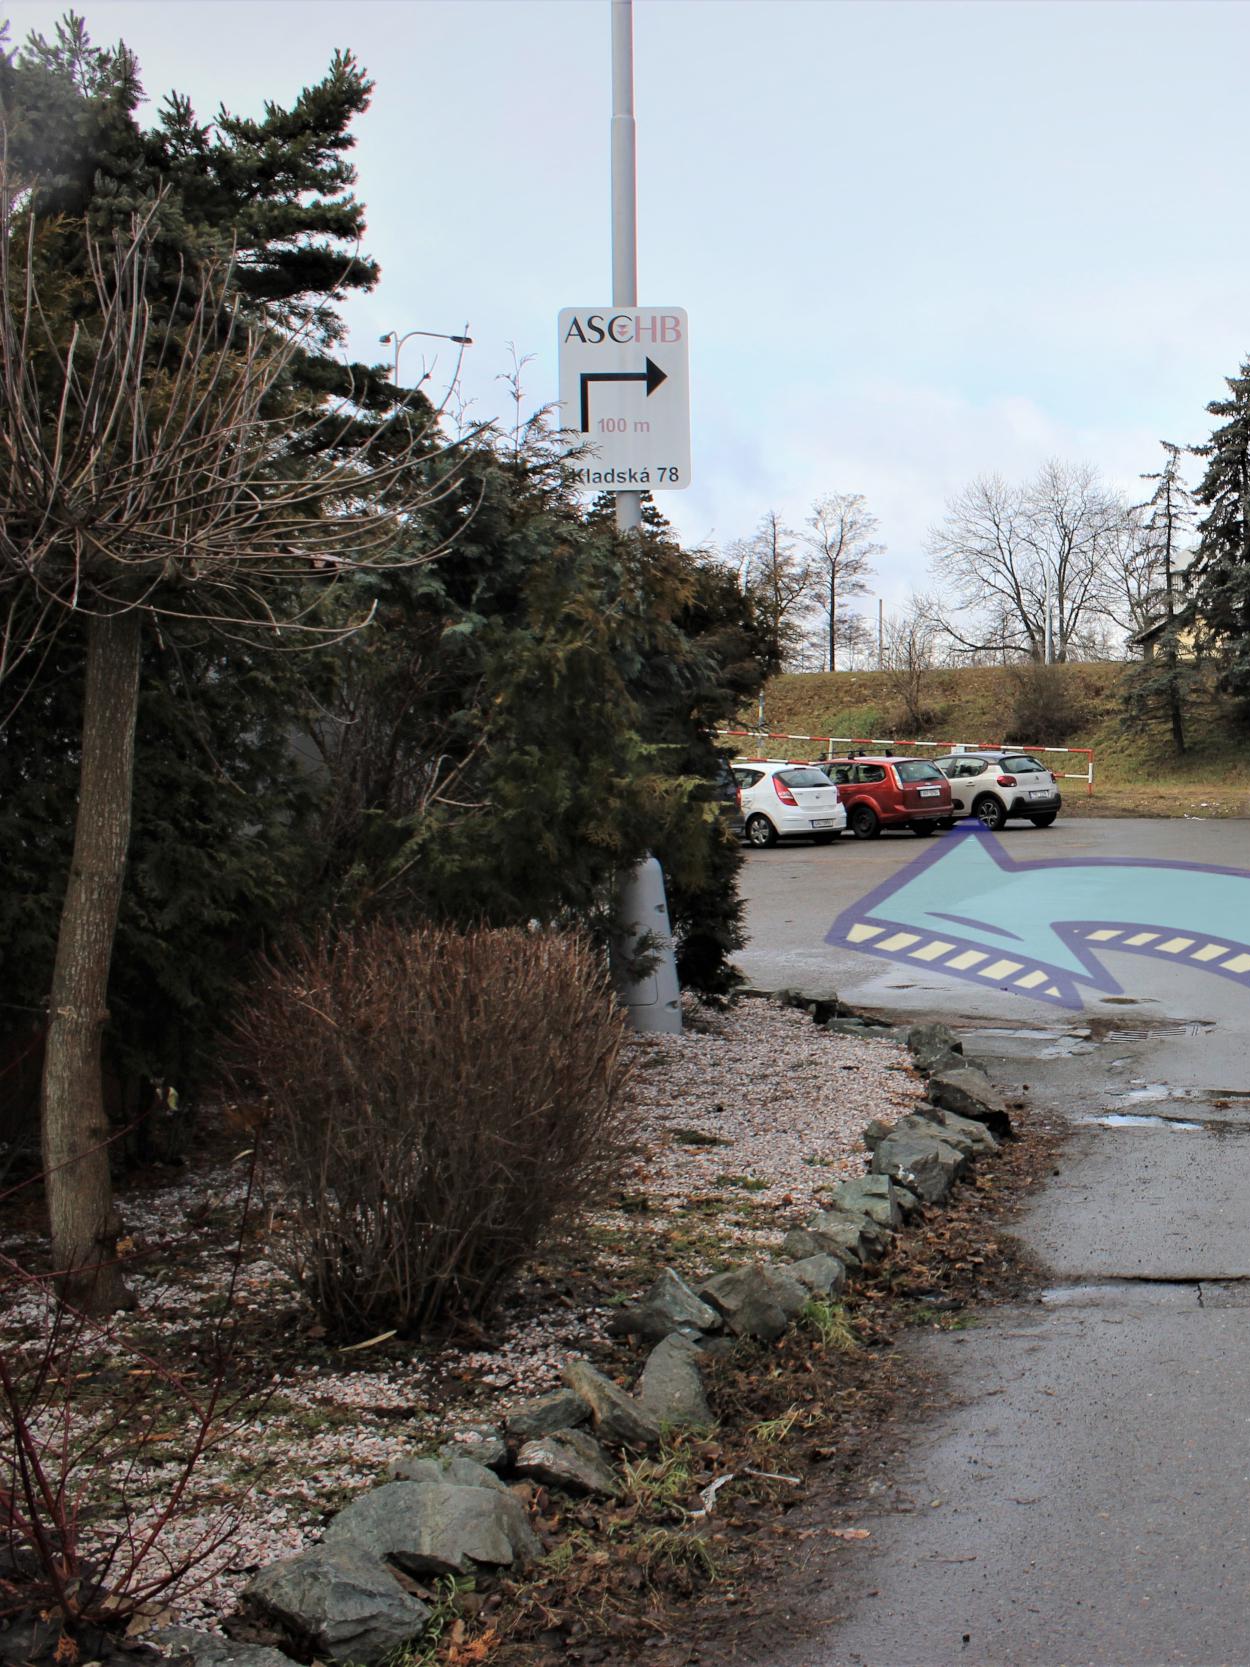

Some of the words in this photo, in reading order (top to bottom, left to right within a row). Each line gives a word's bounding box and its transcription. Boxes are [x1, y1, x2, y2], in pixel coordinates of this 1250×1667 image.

[564, 315, 682, 343] ASCHB
[598, 418, 627, 432] 100
[633, 420, 650, 432] m
[656, 467, 679, 482] 78
